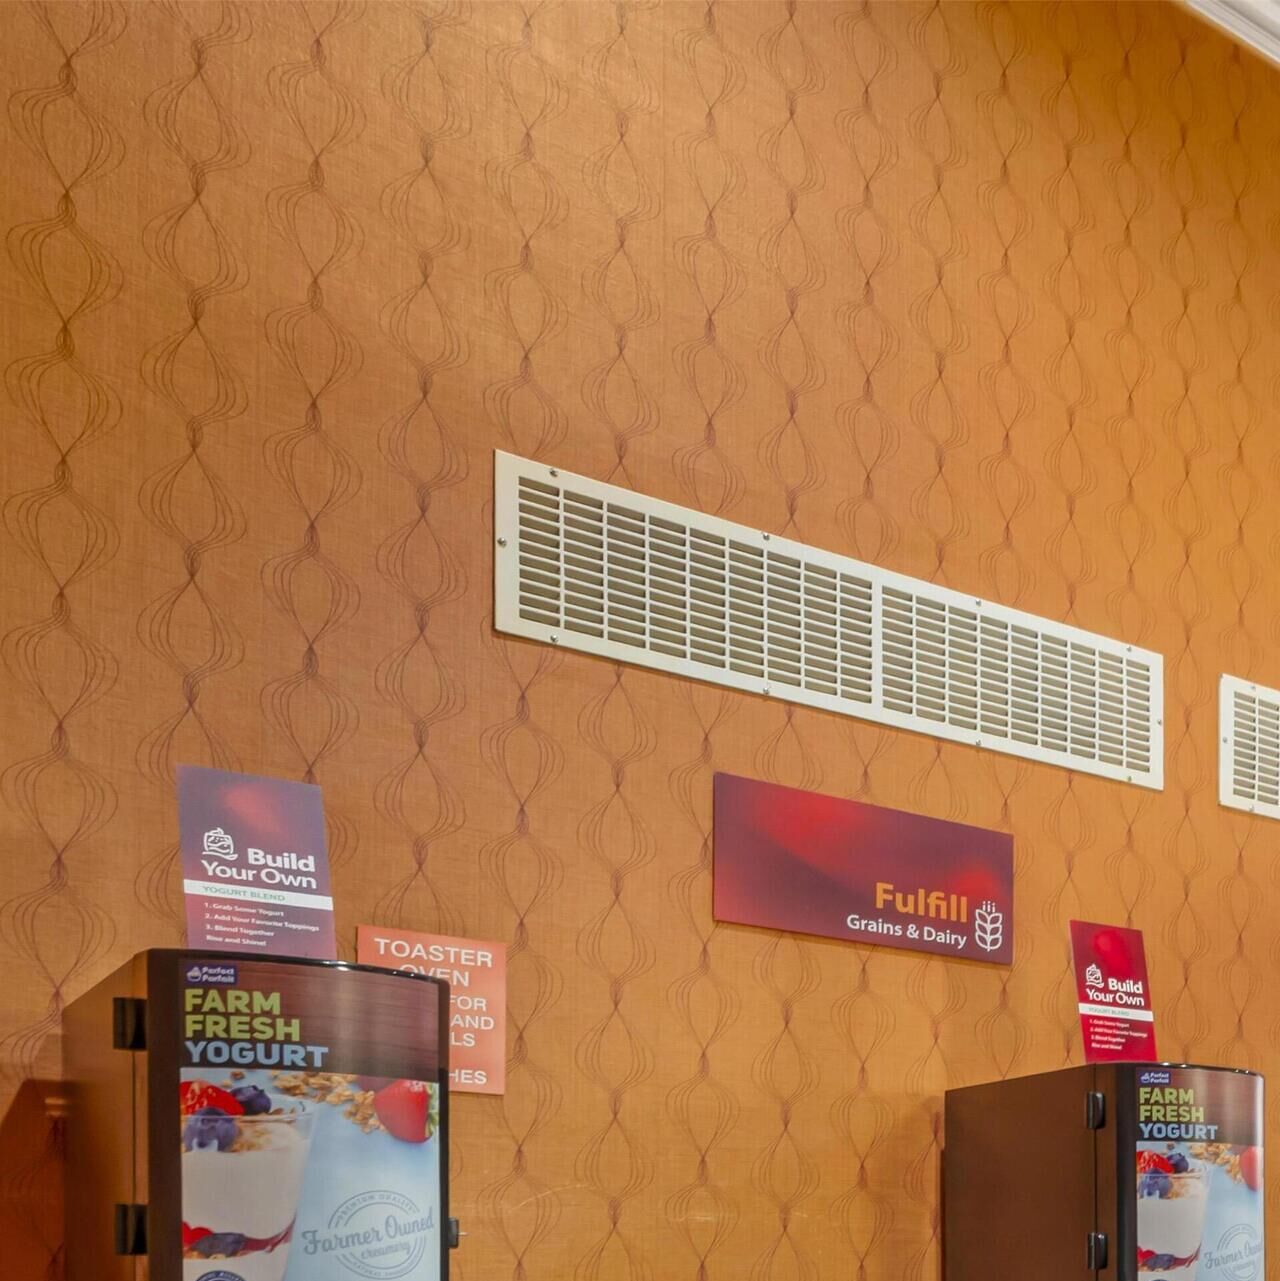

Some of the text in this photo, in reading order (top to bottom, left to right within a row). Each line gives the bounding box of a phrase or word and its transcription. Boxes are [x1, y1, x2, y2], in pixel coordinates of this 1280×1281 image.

[247, 848, 316, 873] Build
[201, 860, 317, 889] Your Own
[202, 885, 285, 901] YOGURT BLEND
[875, 881, 968, 923] Fulfill
[846, 914, 967, 950] Grains & Dairy
[374, 938, 493, 968] TOASTER
[1086, 988, 1145, 1007] Your Own
[1108, 977, 1143, 994] Build
[184, 988, 281, 1015] FARM
[185, 1014, 300, 1042] FRESH
[450, 1014, 494, 1030] AND
[184, 1041, 329, 1068] YOGURT
[1139, 1087, 1194, 1105] FARM
[1140, 1105, 1204, 1123] FRESH
[1139, 1123, 1218, 1139] YOGURT
[301, 1206, 434, 1255] Farmer Owned
